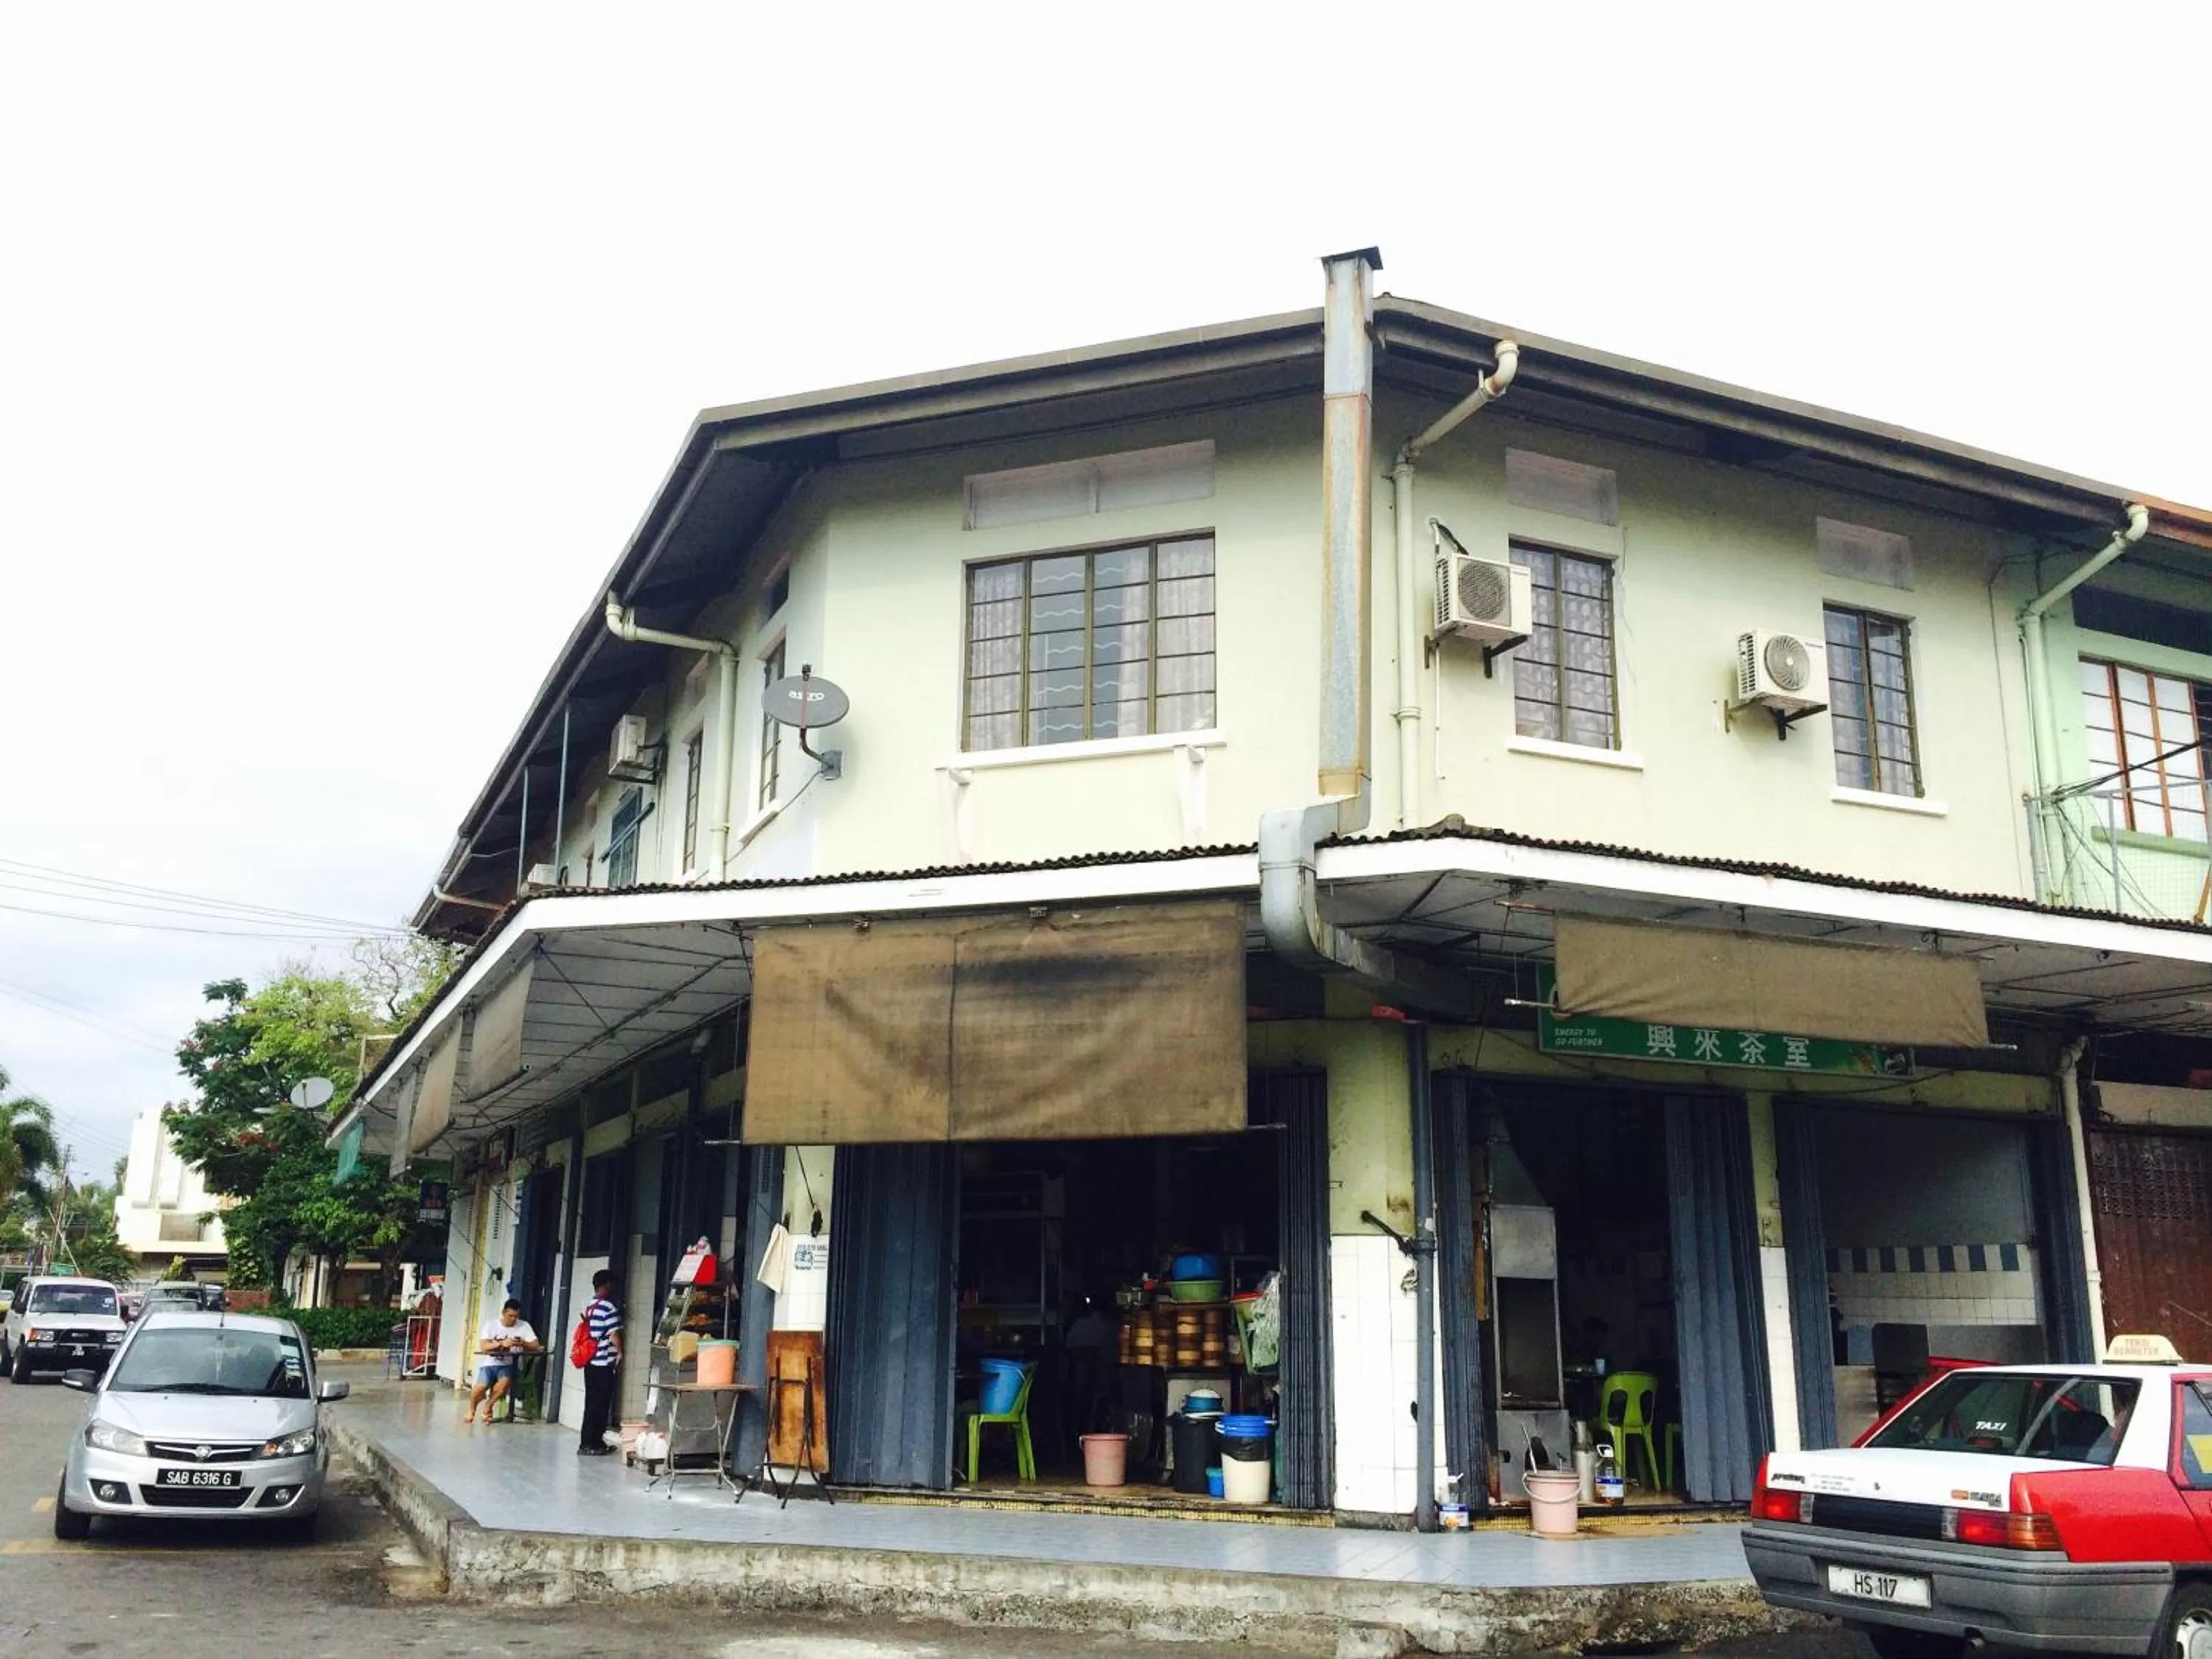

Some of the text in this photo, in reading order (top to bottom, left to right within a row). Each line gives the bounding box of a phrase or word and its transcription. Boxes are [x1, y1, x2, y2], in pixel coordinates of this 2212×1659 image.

[1975, 1421, 2007, 1430] TAXI
[166, 1471, 232, 1486] SAB 6316 G
[1854, 1573, 1898, 1599] HS 117
